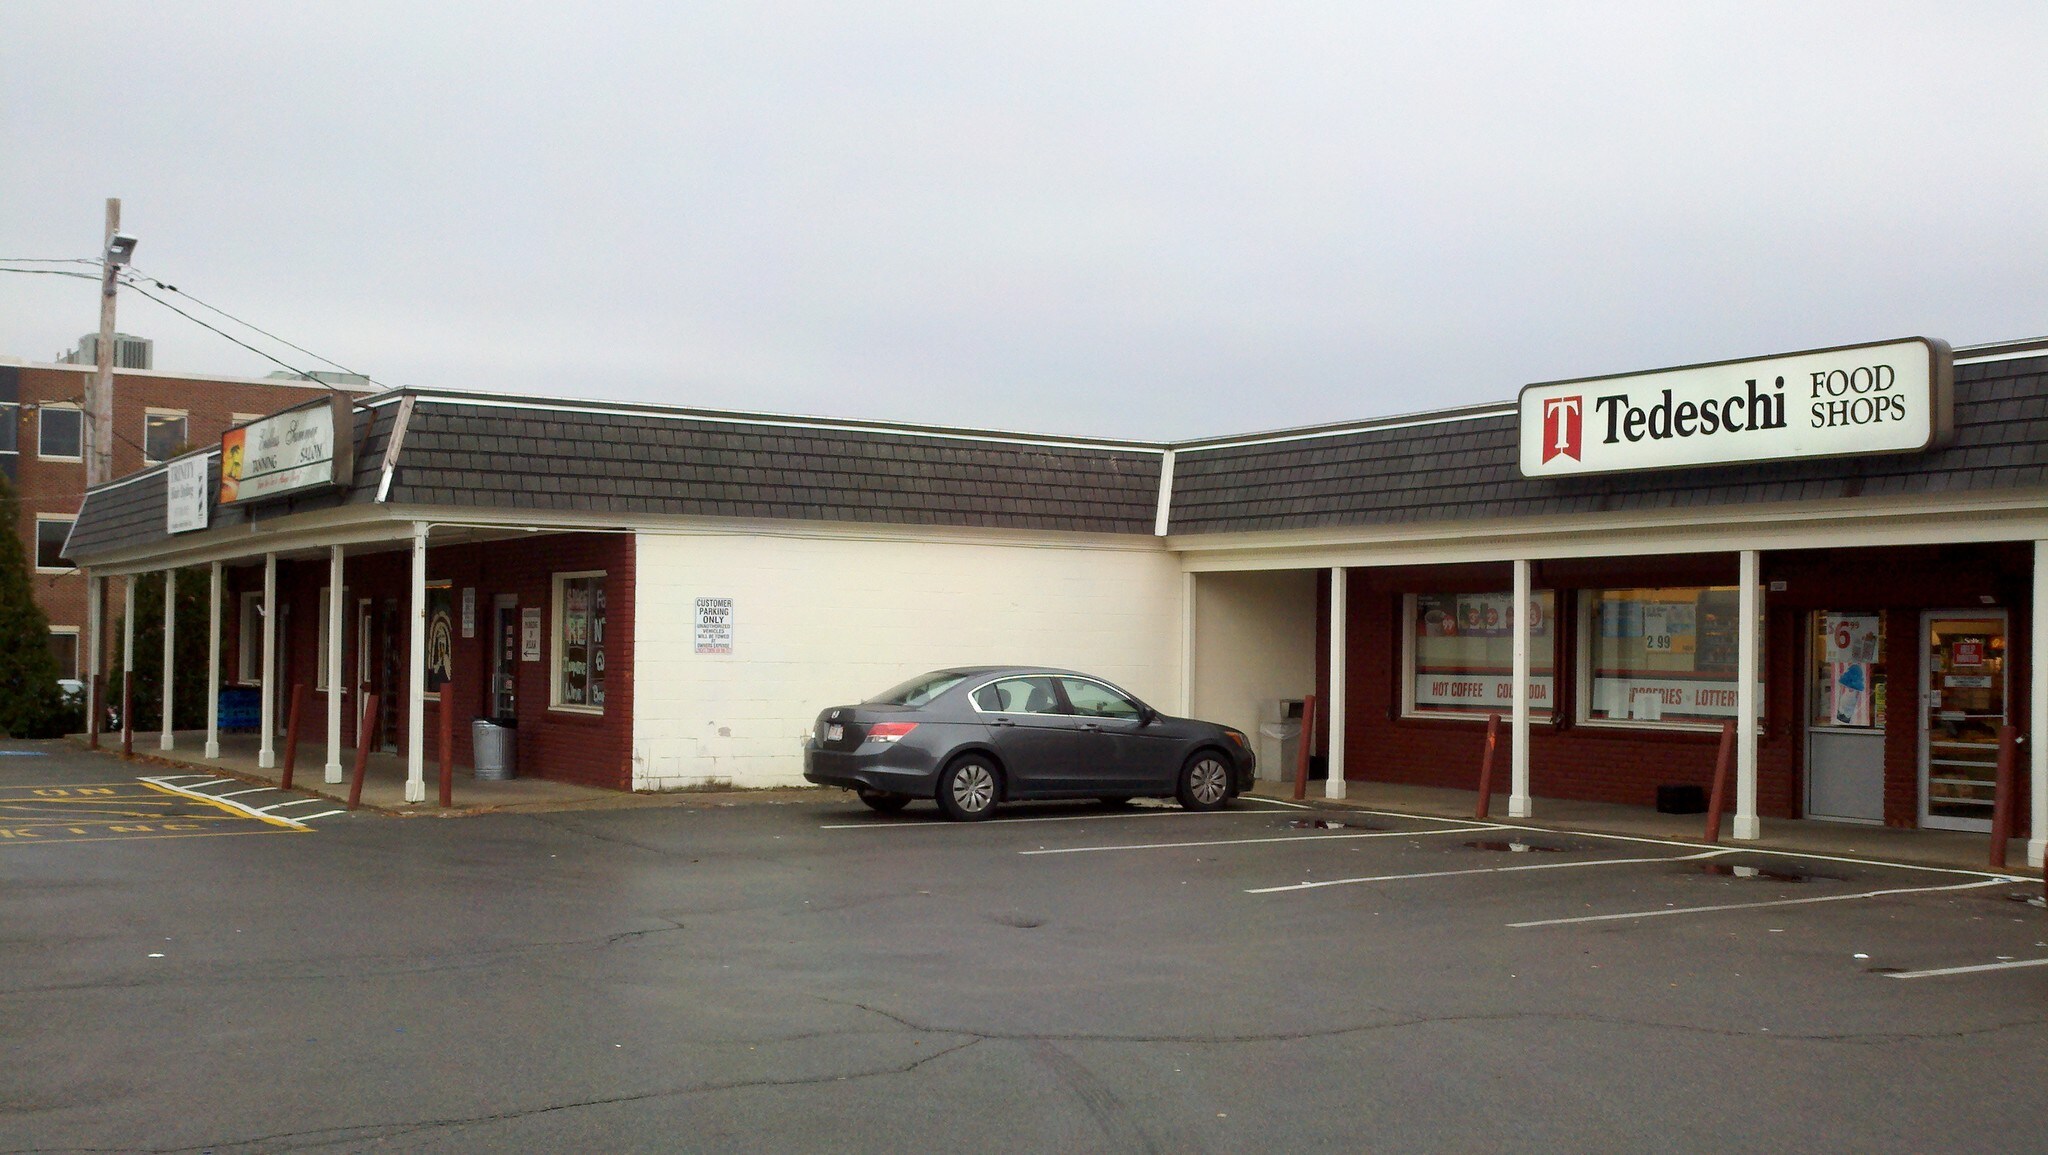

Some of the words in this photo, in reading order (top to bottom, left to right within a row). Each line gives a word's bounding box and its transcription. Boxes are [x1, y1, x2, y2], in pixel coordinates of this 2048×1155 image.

[1810, 364, 1896, 398] FOOD
[1595, 375, 1788, 444] Tedeschi
[1810, 393, 1906, 429] SHOPS
[252, 454, 278, 473] TANNING
[301, 443, 323, 462] SALON
[697, 599, 732, 608] CUSTOMER
[699, 607, 729, 616] PARKING
[702, 615, 724, 624] ONLY
[1432, 681, 1449, 696] HOT
[1451, 682, 1483, 698] COFFEE
[1496, 683, 1513, 699] COL
[1529, 684, 1547, 700] ODA
[1695, 689, 1738, 707] LOTTER
